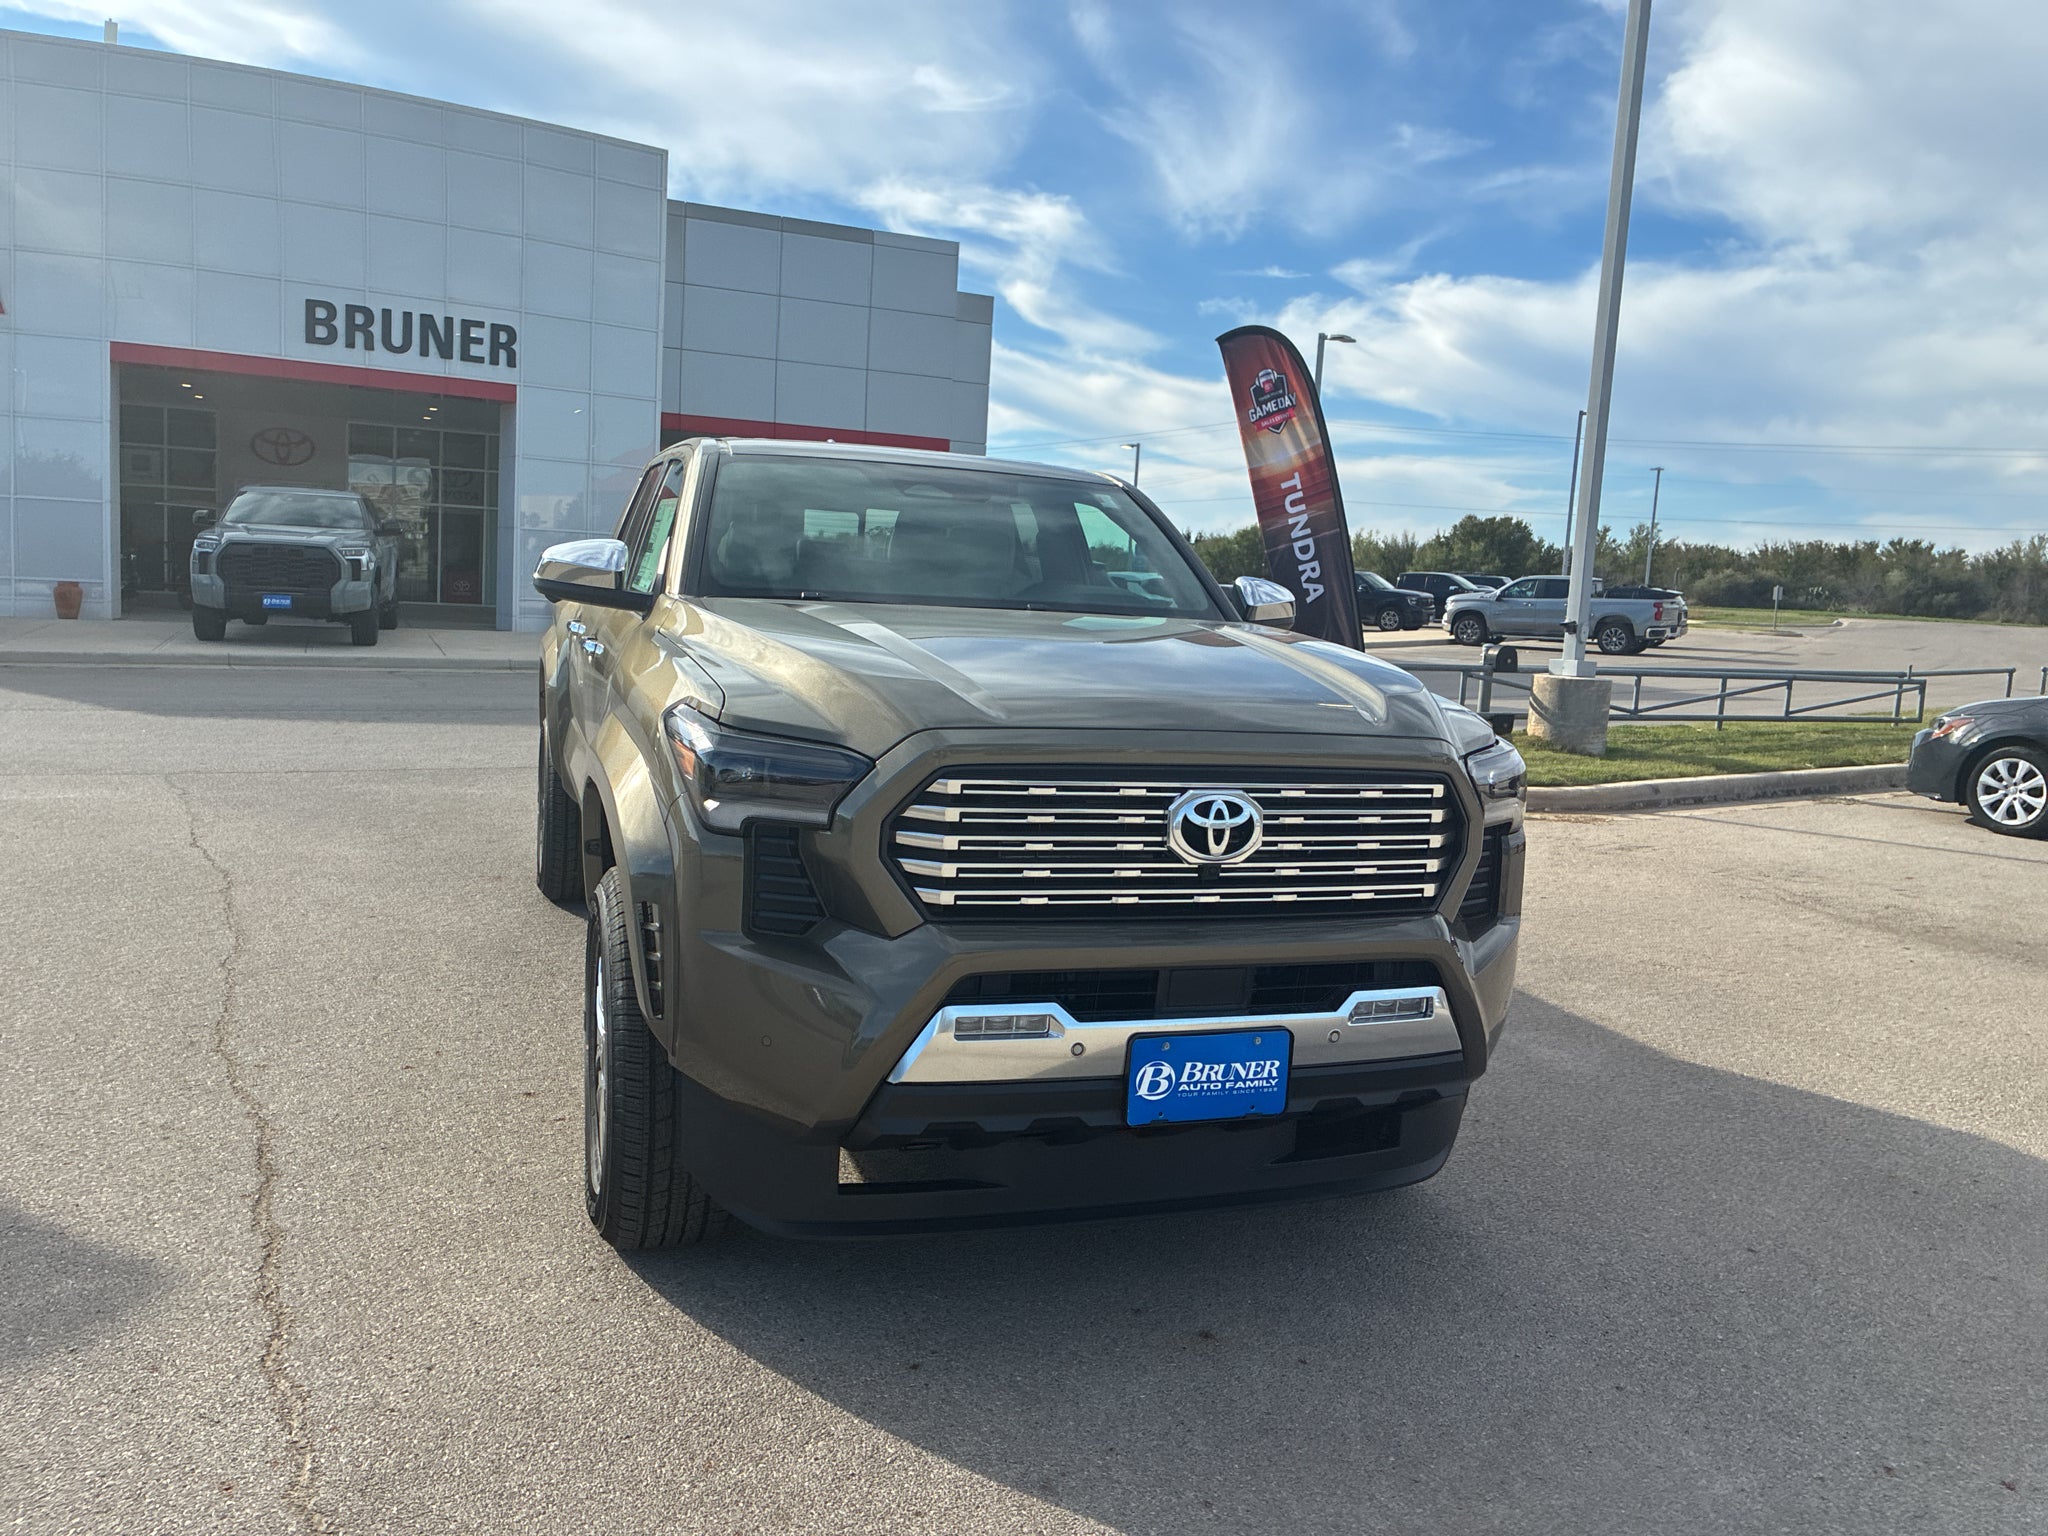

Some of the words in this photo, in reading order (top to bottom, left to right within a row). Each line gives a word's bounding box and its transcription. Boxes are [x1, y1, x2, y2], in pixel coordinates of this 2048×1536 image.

[304, 298, 517, 368] BRUNER
[1248, 392, 1296, 422] GAMEDAY
[1279, 472, 1326, 605] TUNDRA
[1178, 1060, 1280, 1082] BRUNER
[1178, 1083, 1222, 1091] AUTO
[1225, 1079, 1280, 1089] FAMILY
